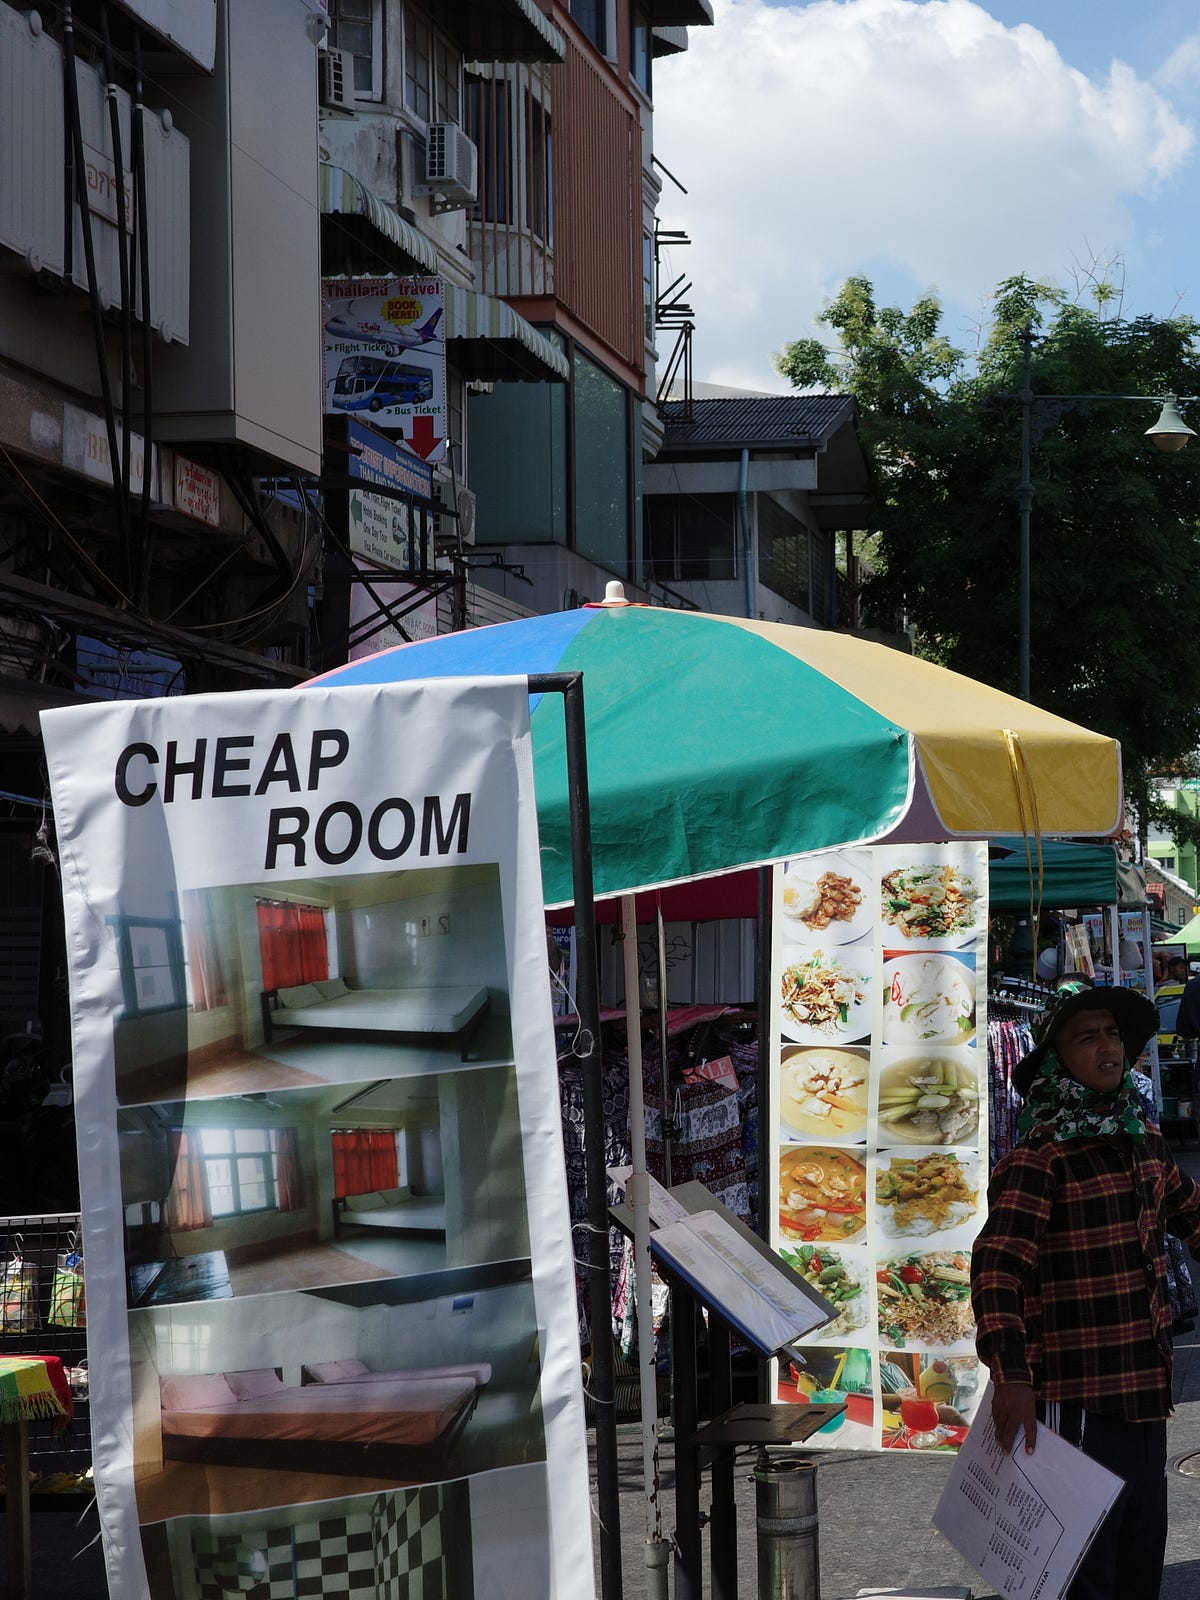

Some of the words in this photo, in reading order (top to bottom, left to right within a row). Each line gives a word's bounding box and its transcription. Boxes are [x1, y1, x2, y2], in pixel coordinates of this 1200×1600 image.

[326, 283, 388, 297] Thailand
[398, 282, 439, 295] travel
[387, 301, 416, 310] BOOK
[334, 343, 360, 354] Flight
[363, 342, 390, 352] Ticket
[394, 407, 411, 415] Bus
[414, 405, 441, 414] Ticket
[114, 728, 350, 807] CHEAP
[264, 792, 472, 870] ROOM
